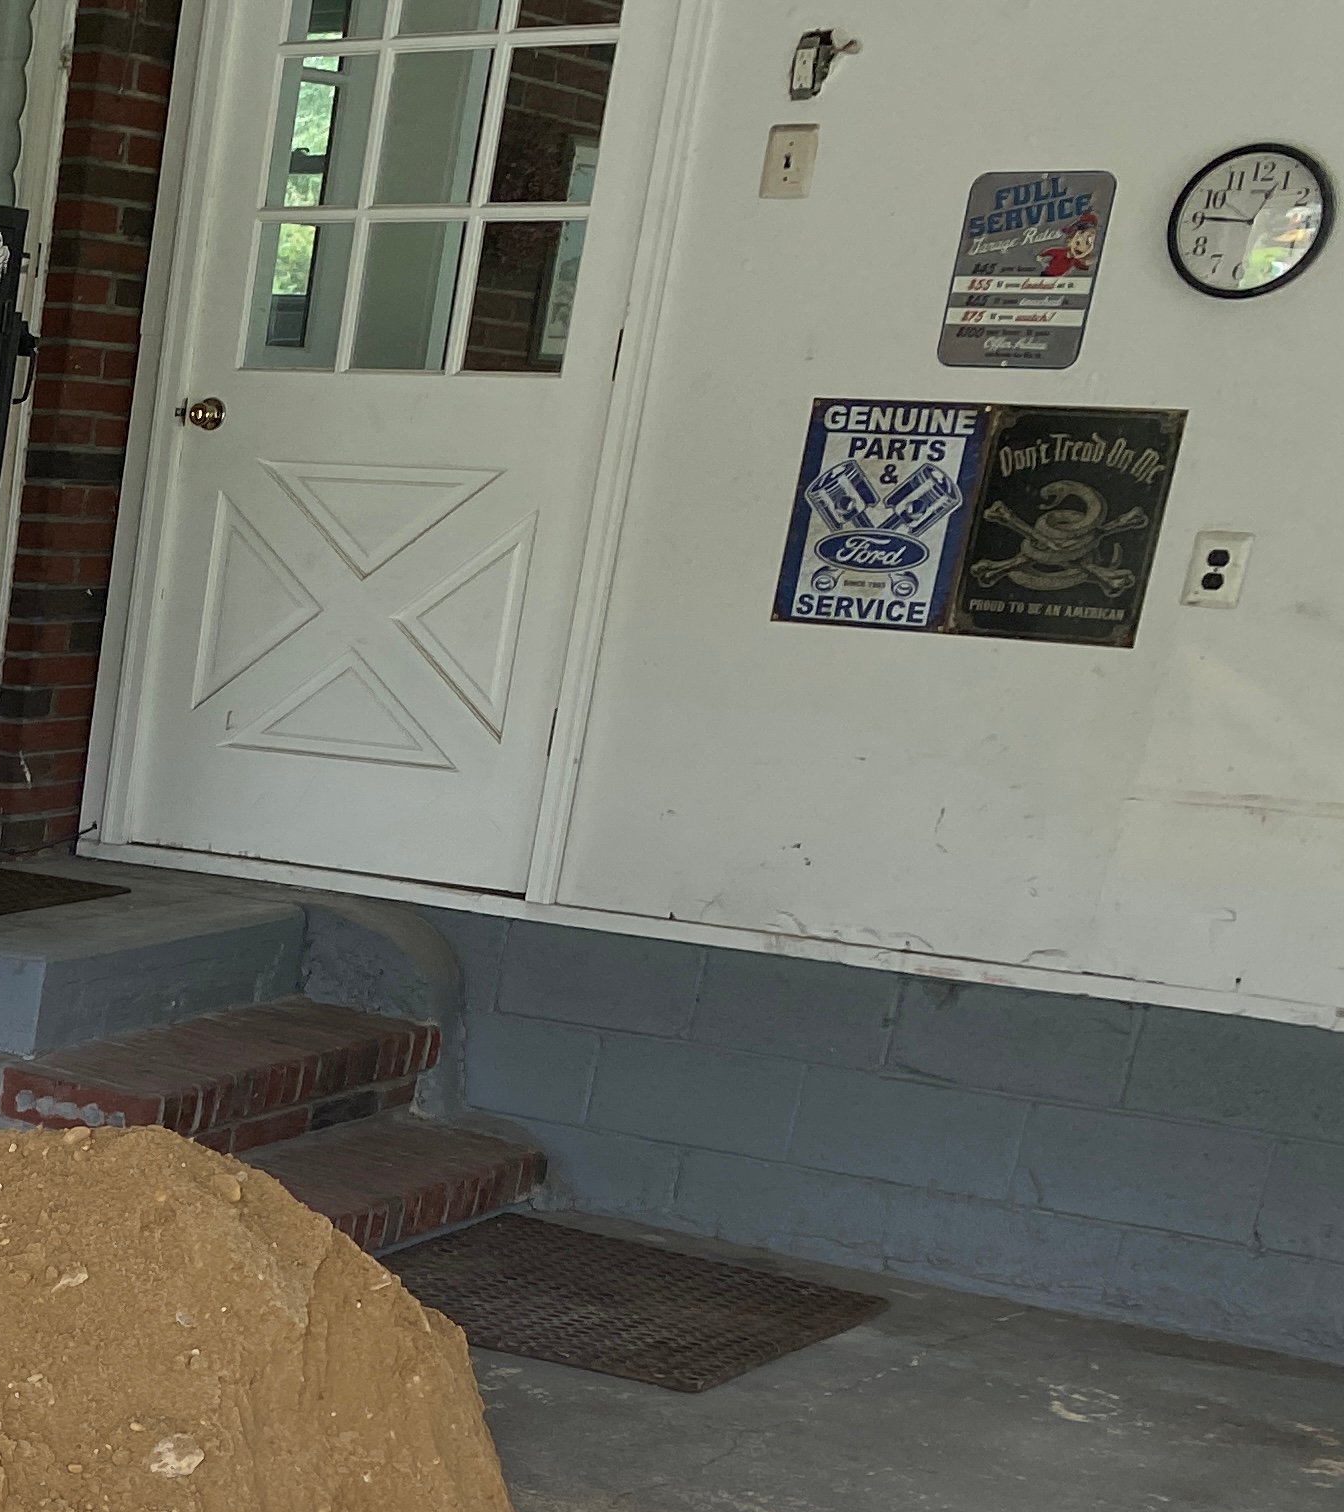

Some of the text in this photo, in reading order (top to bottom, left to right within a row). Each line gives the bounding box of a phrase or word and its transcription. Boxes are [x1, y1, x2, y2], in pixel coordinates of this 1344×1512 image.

[1226, 171, 1245, 191] 11
[1252, 161, 1277, 182] 12
[1280, 171, 1290, 190] 1
[994, 177, 1067, 209] FULL
[1204, 189, 1227, 210] 10
[1294, 187, 1310, 207] 2
[968, 193, 1093, 238] SERVICE
[1192, 211, 1205, 231] 9
[1022, 227, 1063, 245] Rates
[1192, 236, 1208, 256] 8
[1210, 254, 1223, 274] 7
[967, 279, 993, 291] $55
[961, 310, 986, 322] $75
[824, 405, 977, 435] GENUINE
[848, 437, 946, 462] PARTS
[999, 432, 1166, 484] Don't Tread On Me
[880, 464, 898, 484] &
[835, 535, 907, 566] Ford
[844, 579, 866, 588] SINCE
[796, 594, 927, 624] SERVICE
[969, 599, 1126, 621] PROUD TO BE AN AMERICAN
